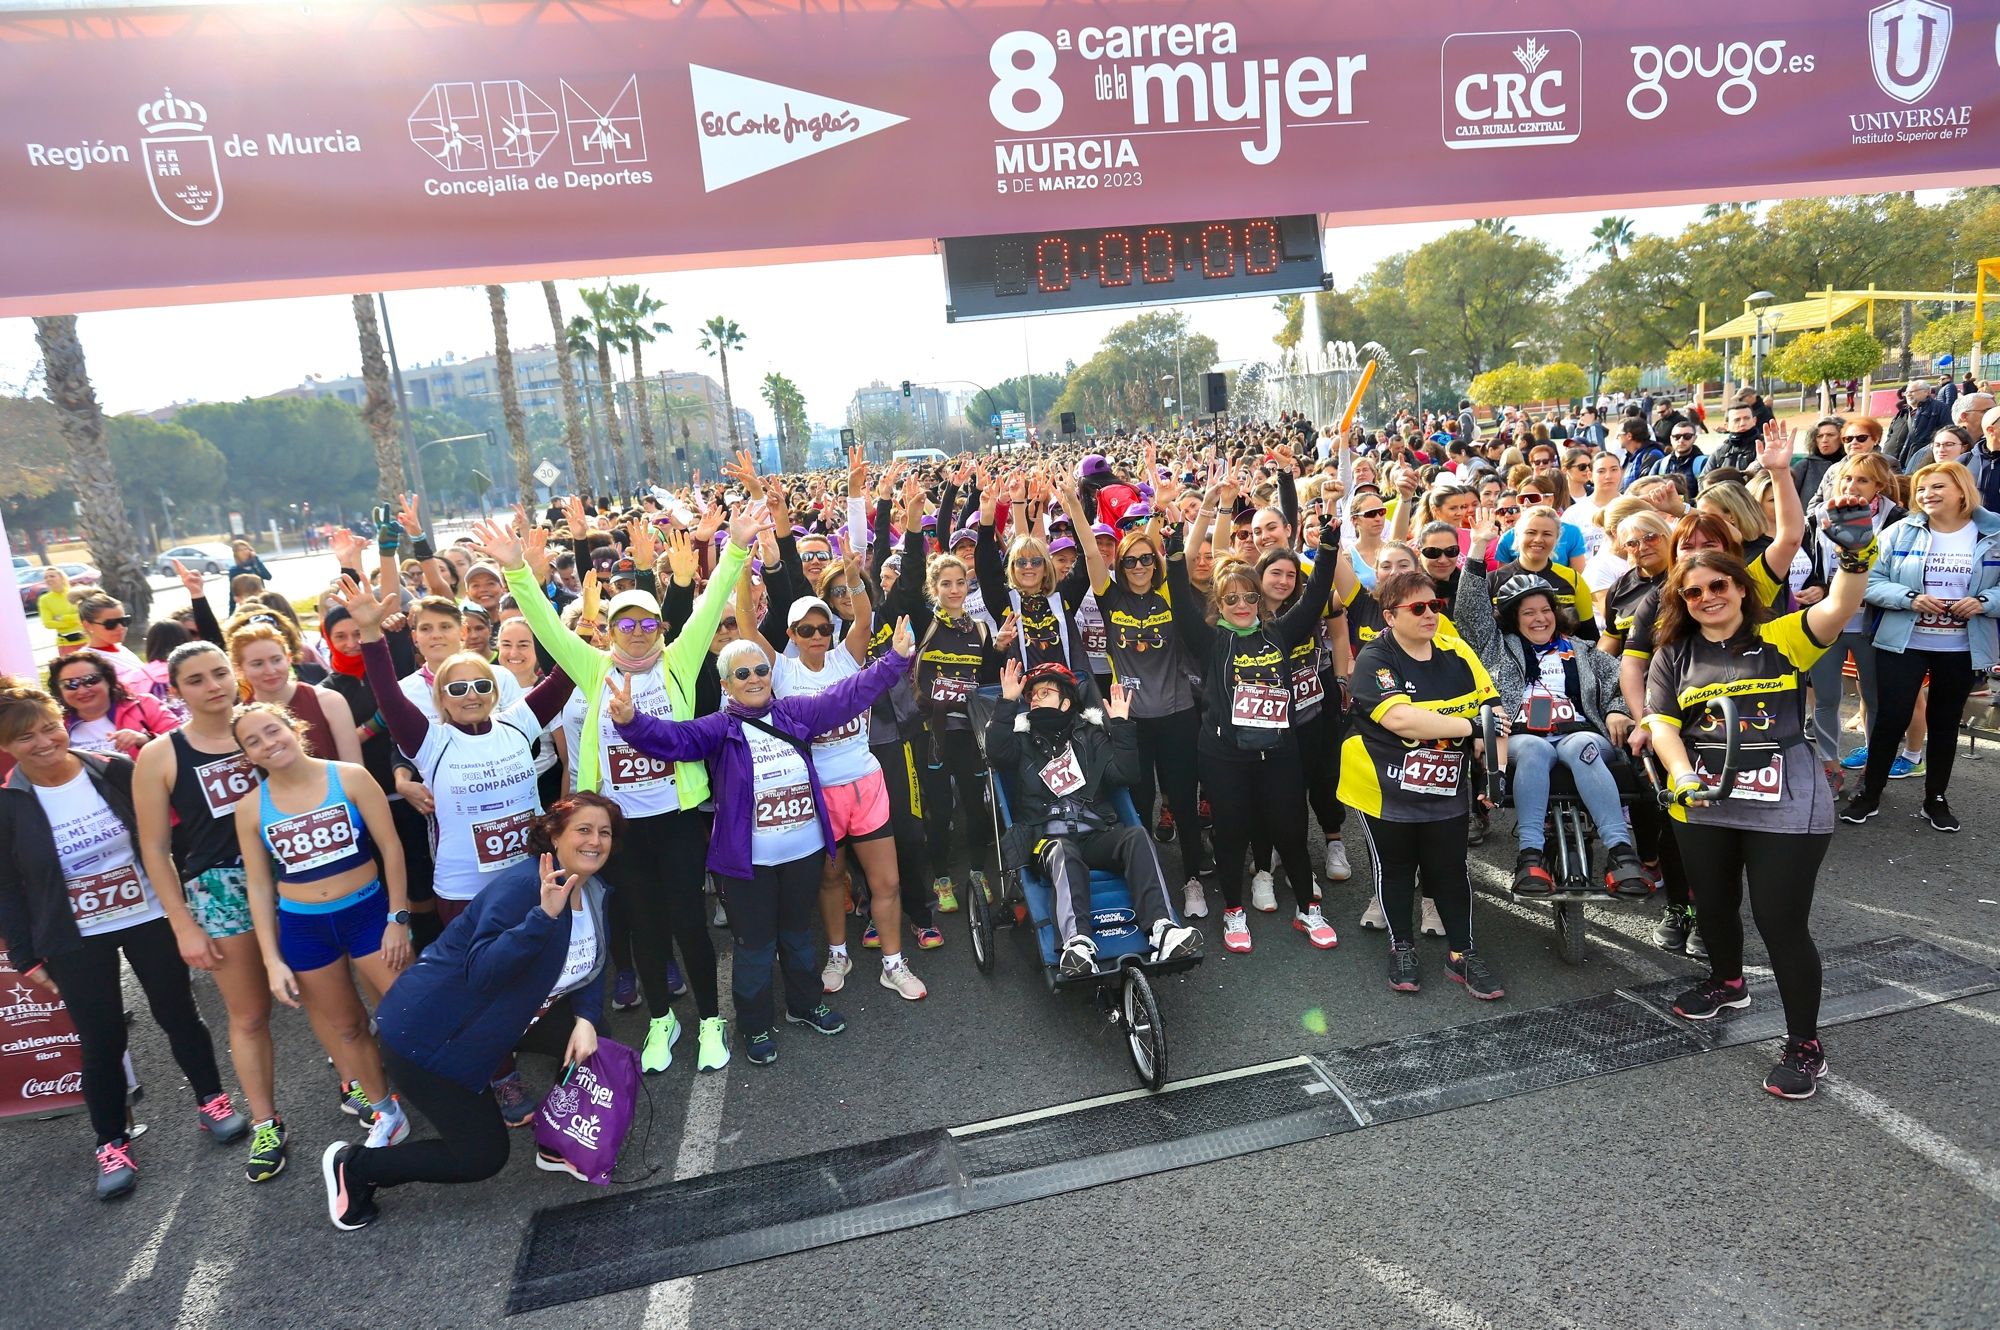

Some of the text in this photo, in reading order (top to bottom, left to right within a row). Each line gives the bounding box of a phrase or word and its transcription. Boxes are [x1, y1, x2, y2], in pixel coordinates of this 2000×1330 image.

[1078, 22, 1237, 60] carrera
[1455, 69, 1566, 121] CRC
[1131, 53, 1367, 166] mujer
[1849, 106, 1972, 132] UNIVERSAE
[701, 103, 860, 144] El Corte Inglés
[1455, 121, 1566, 136] CAJA RURAL CENTRAL
[1853, 127, 1968, 144] Instituto Superior de FP
[26, 129, 361, 171] Región de Murcia
[995, 138, 1139, 174] MURCIA
[424, 168, 653, 196] Concejalía de Deportes
[997, 171, 1143, 194] 5 DE MARZO 2023
[540, 468, 553, 479] 30
[1684, 687, 1723, 704] ZANCADAS
[1723, 683, 1754, 694] SOBRE
[1235, 697, 1287, 717] 4787
[468, 766, 535, 794] COMPAÑERAS
[619, 757, 667, 778] 296
[1405, 761, 1459, 783] 4793
[758, 796, 814, 822] 2482
[275, 821, 350, 858] 2888
[35, 1050, 62, 1061] fibra
[578, 1073, 614, 1105] mujer
[570, 1114, 602, 1141] CRC
